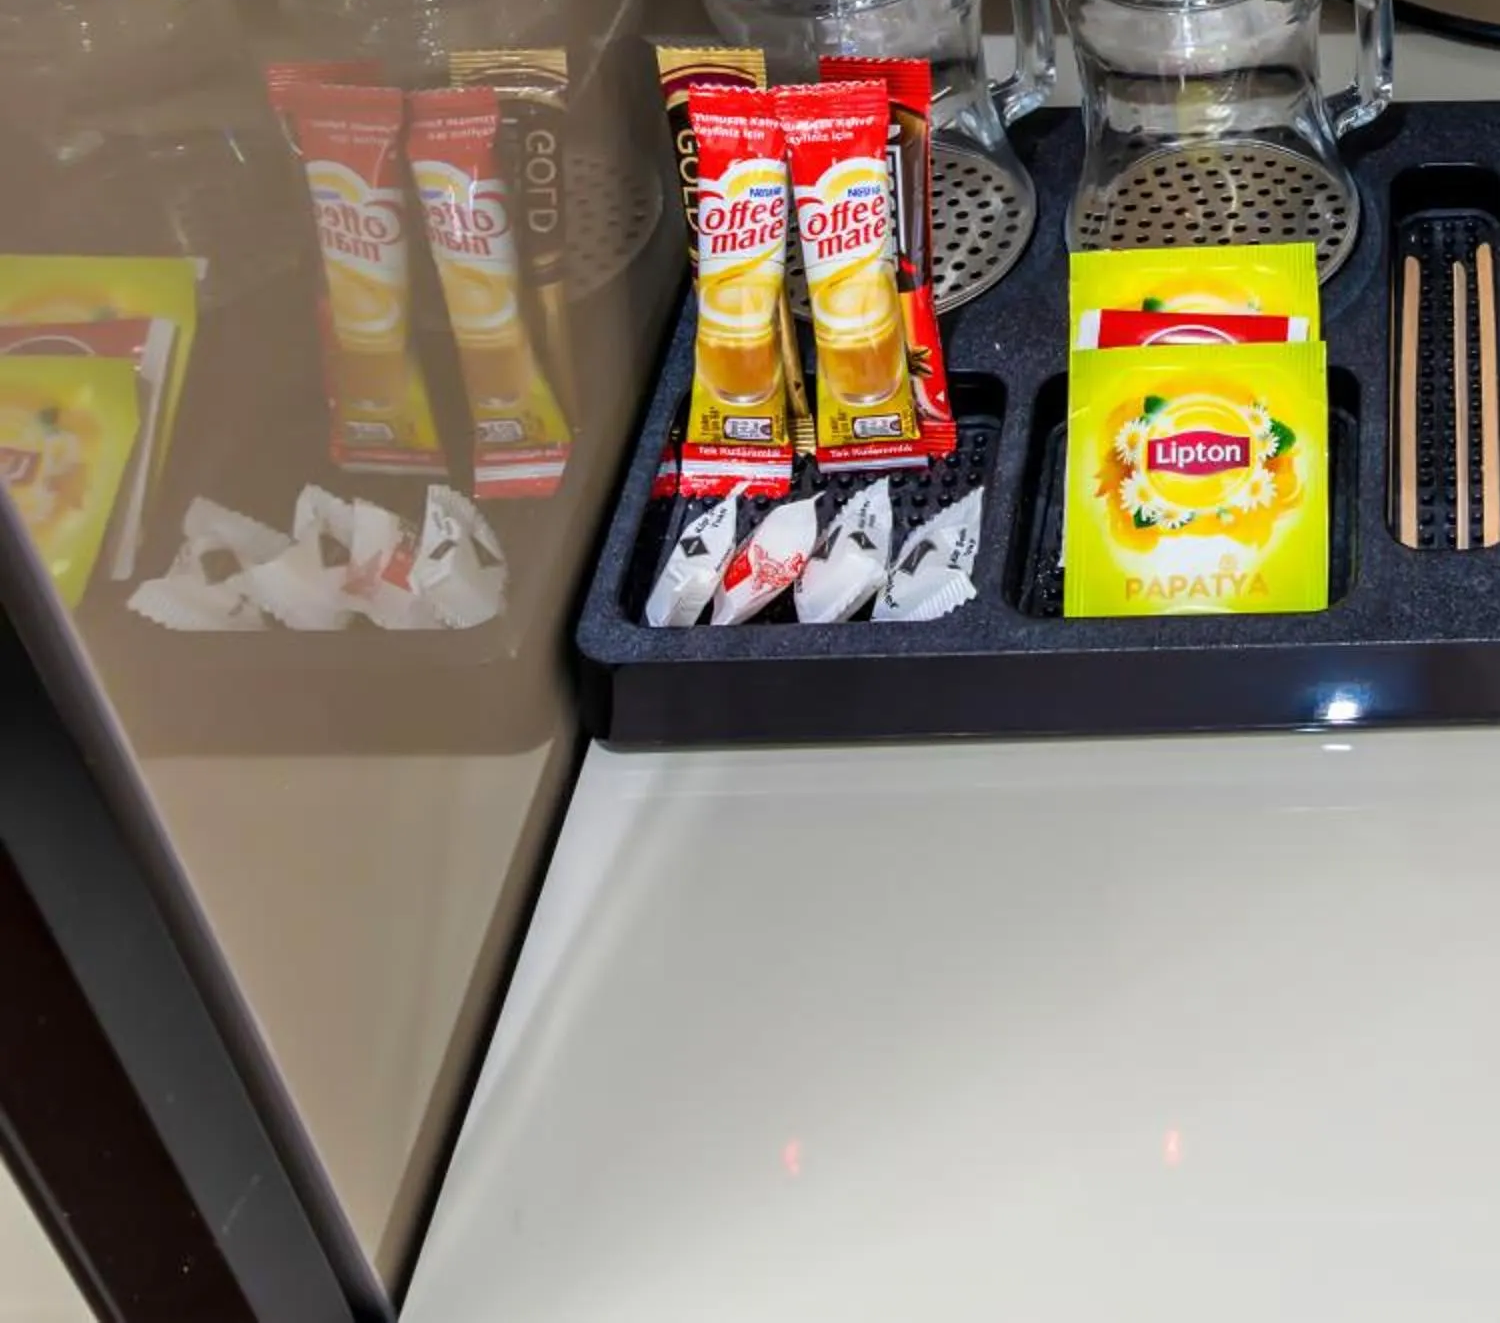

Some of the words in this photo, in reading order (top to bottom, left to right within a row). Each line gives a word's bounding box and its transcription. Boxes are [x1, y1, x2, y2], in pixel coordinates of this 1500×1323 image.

[692, 190, 785, 237] Coffee
[794, 195, 886, 242] Coffee
[711, 218, 785, 254] mate
[817, 217, 887, 260] mate
[1155, 441, 1241, 468] Lipton
[1124, 571, 1270, 602] PAPATYA
